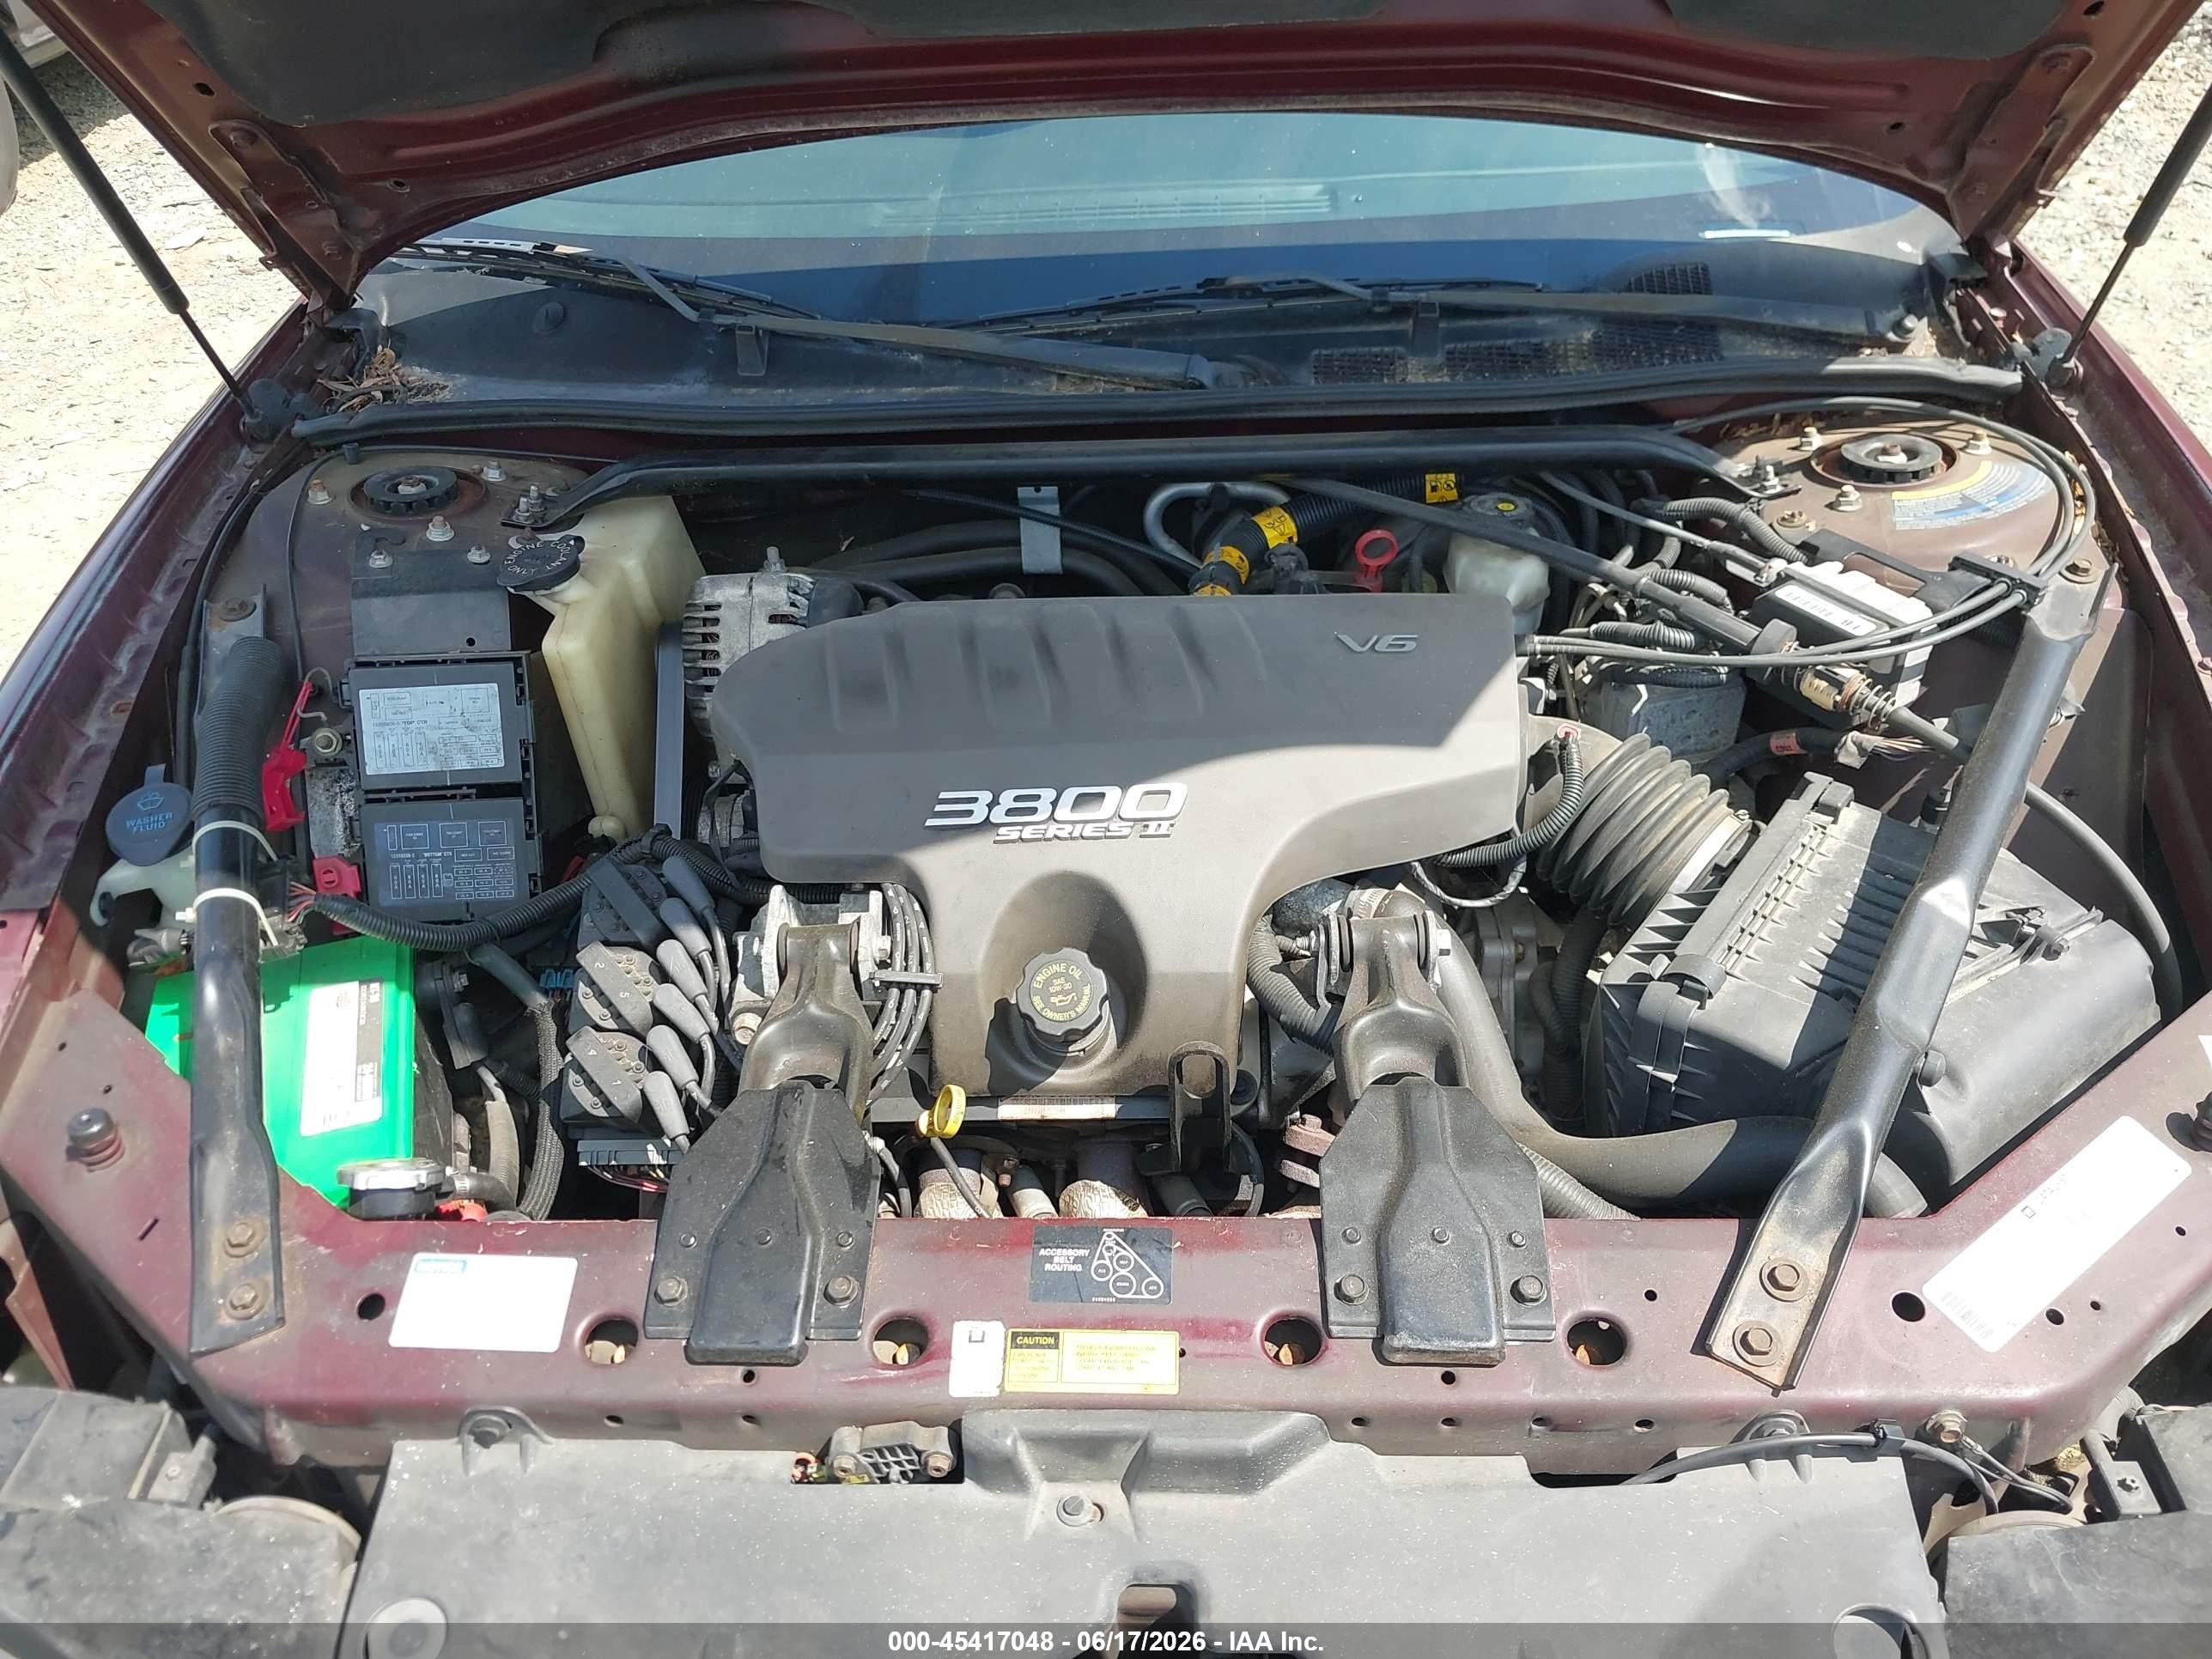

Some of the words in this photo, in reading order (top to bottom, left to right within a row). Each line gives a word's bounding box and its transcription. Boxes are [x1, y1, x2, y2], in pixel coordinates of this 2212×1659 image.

[504, 541, 544, 564] ENGINE
[545, 541, 571, 570] COOLANT
[507, 565, 537, 574] ONLY
[1335, 632, 1419, 653] V6
[924, 783, 1188, 828] 3800
[125, 812, 173, 828] WASHER
[132, 821, 166, 833] FLUID
[994, 822, 1133, 843] SERIES
[1139, 820, 1176, 839] II
[1034, 963, 1067, 989] ENGINE
[1068, 965, 1084, 981] OIL
[1048, 982, 1073, 994] 10W-30
[1031, 996, 1044, 1011] SEE
[1042, 1008, 1076, 1021] OWNER'S
[1075, 983, 1091, 1014] MANUAL
[1038, 1249, 1090, 1257] ACCESSORY
[1044, 1263, 1083, 1272] ROUTING
[1016, 1335, 1055, 1346] CAUTION
